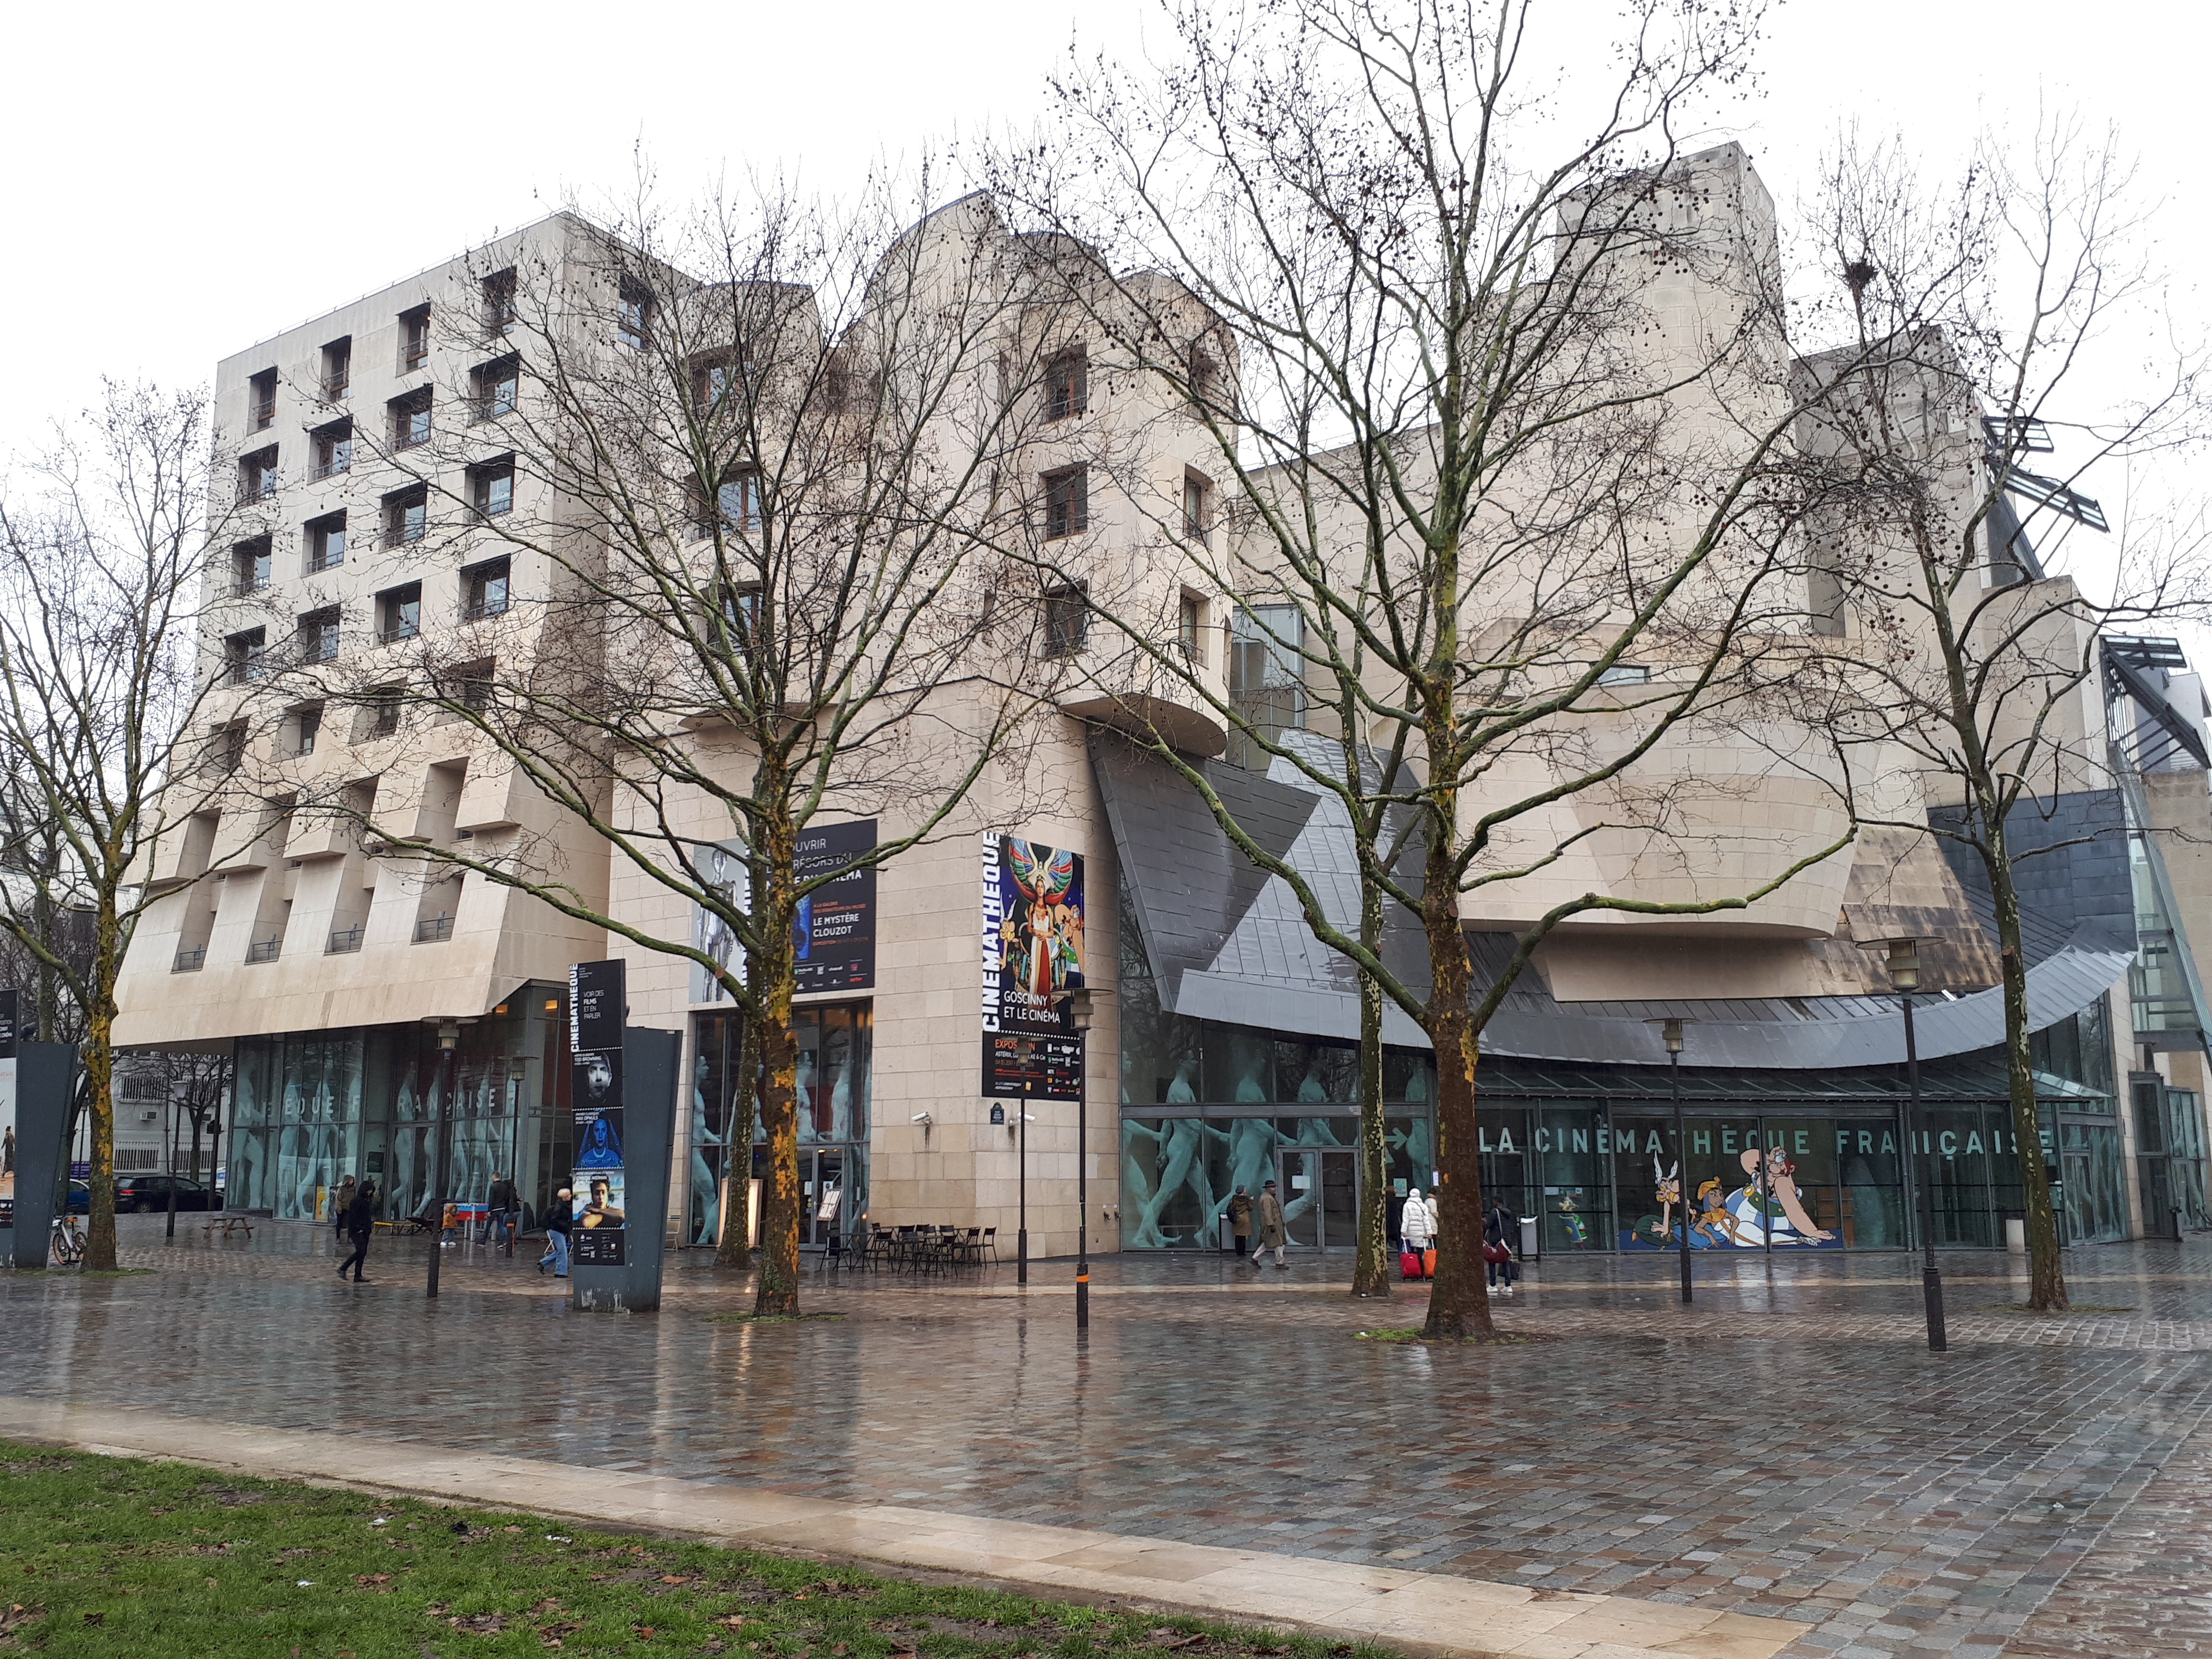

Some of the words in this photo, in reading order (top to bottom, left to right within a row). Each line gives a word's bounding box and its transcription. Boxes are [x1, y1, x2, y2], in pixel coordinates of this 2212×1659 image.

[793, 839, 826, 853] UVRIR
[792, 855, 834, 870] RÉSORS
[813, 917, 823, 926] LE
[824, 912, 859, 925] MYSTÈRE
[813, 926, 853, 938] CLOUZOT
[983, 831, 1001, 1032] CINEMATHEQUE
[1004, 990, 1047, 1006] GOSCINNY
[569, 963, 579, 1053] CINEMATHEQUE
[1004, 1006, 1015, 1019] ET
[1017, 1008, 1027, 1020] LE
[1028, 1009, 1061, 1024] CINÉMA
[583, 1012, 601, 1020] PARLER
[995, 1038, 1036, 1051] EXPOSN
[1479, 1126, 1515, 1153] LA
[1536, 1123, 1810, 1154] CINÉMAHÈQUE
